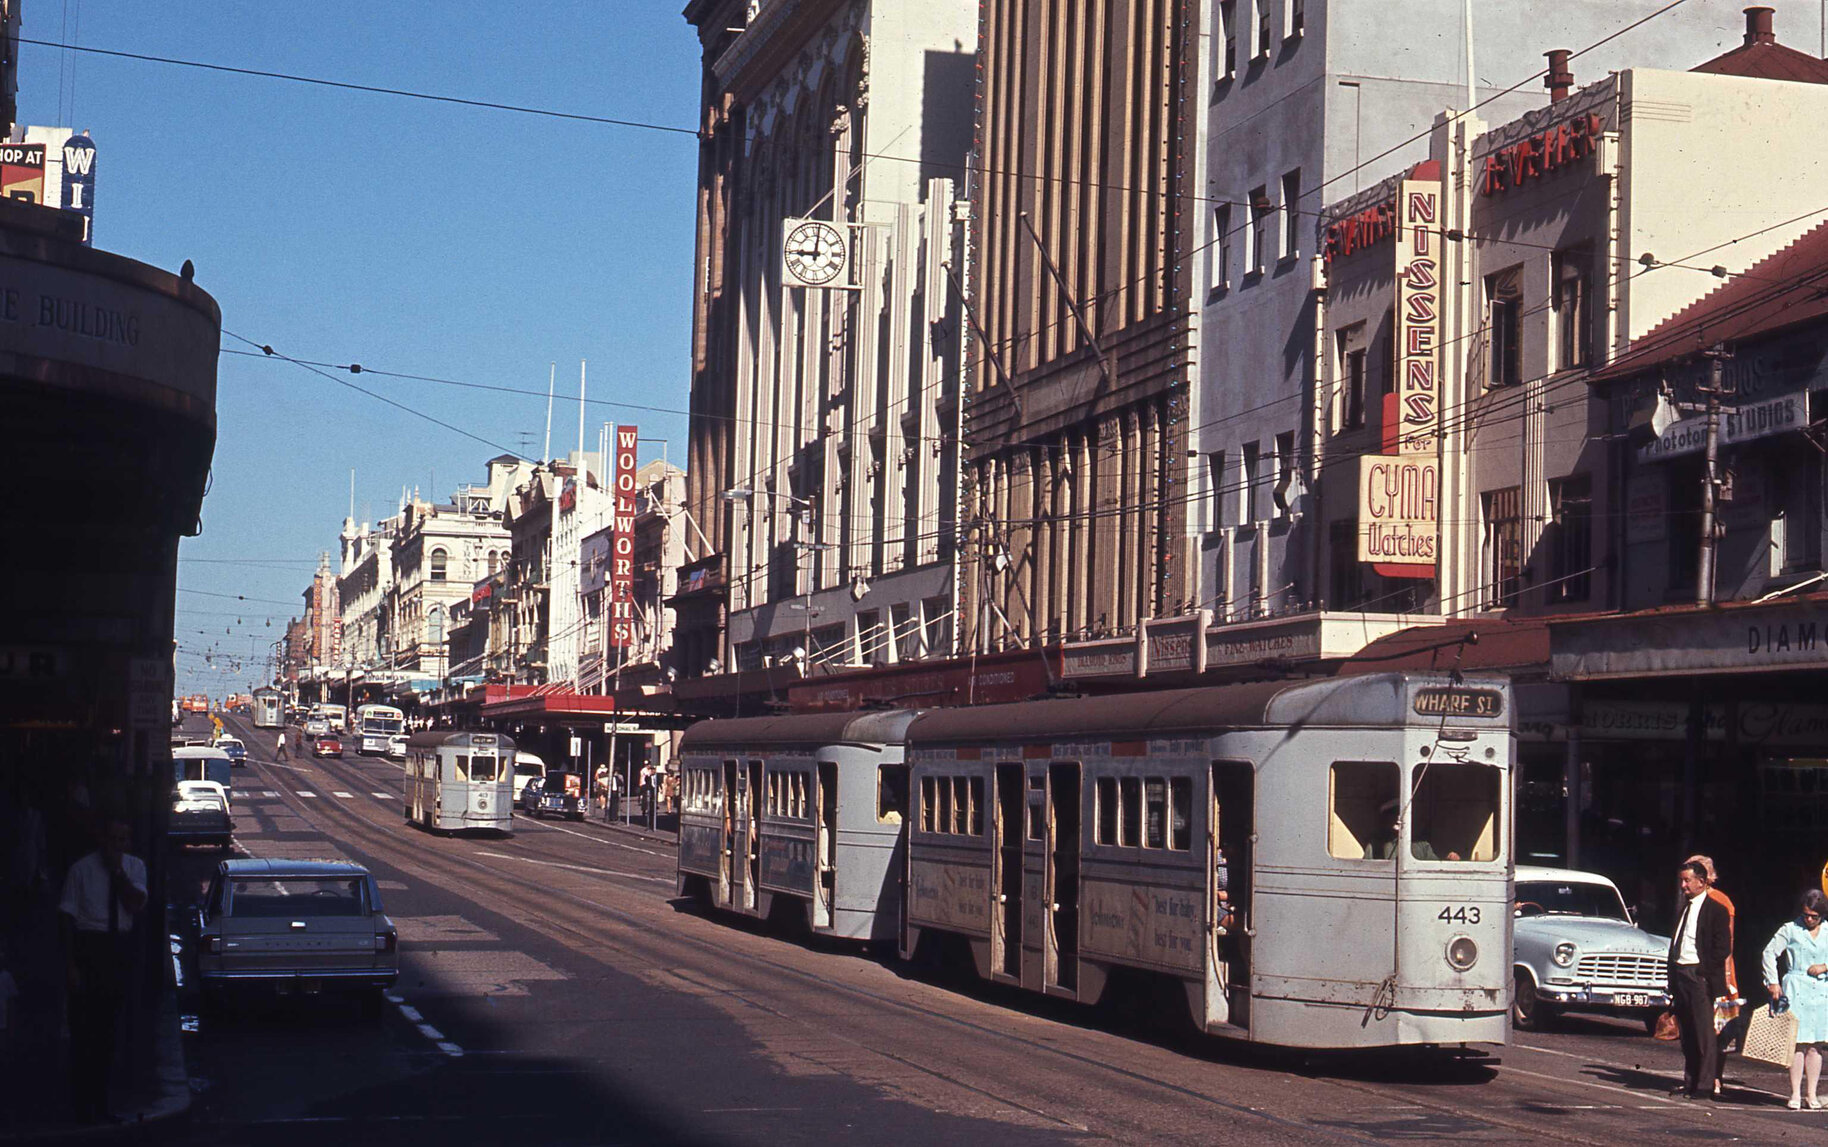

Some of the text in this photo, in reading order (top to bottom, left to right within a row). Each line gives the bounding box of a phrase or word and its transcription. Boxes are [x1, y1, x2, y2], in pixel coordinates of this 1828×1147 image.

[25, 151, 43, 164] AT
[38, 294, 138, 346] BUILDING
[1404, 192, 1436, 425] NISSENS
[1726, 398, 1795, 439] STUDIOS
[1368, 463, 1437, 520] CYMA
[614, 432, 636, 640] WOOLWORTHS
[1368, 522, 1435, 557] Watches
[1224, 636, 1293, 655] FINE WATCHES
[1749, 622, 1828, 654] DIAM
[979, 671, 1015, 686] CONDITIONED
[1415, 693, 1493, 714] WHARF ST
[1438, 906, 1481, 924] 443
